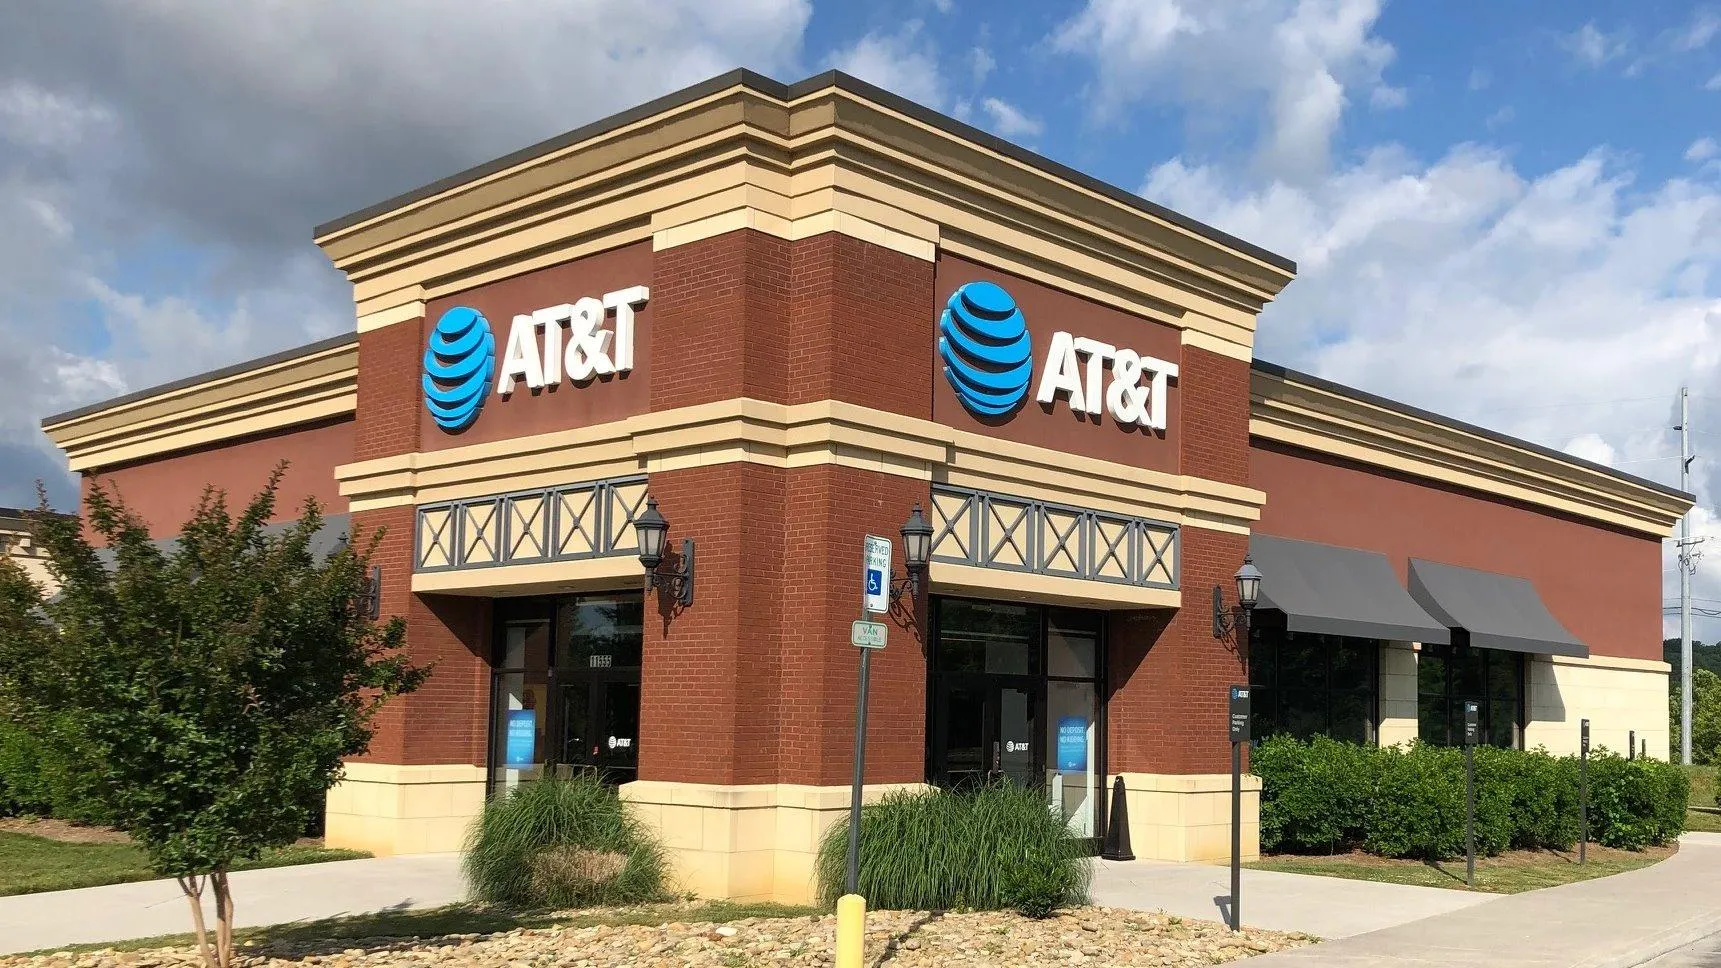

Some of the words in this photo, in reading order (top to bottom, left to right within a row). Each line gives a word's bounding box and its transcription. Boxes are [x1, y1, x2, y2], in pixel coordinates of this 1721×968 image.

[497, 285, 650, 394] AT&T
[1036, 331, 1179, 430] AT&T
[862, 626, 878, 636] VAN
[1060, 726, 1067, 734] NO
[616, 738, 632, 747] AT&T
[1014, 742, 1029, 751] AT&T
